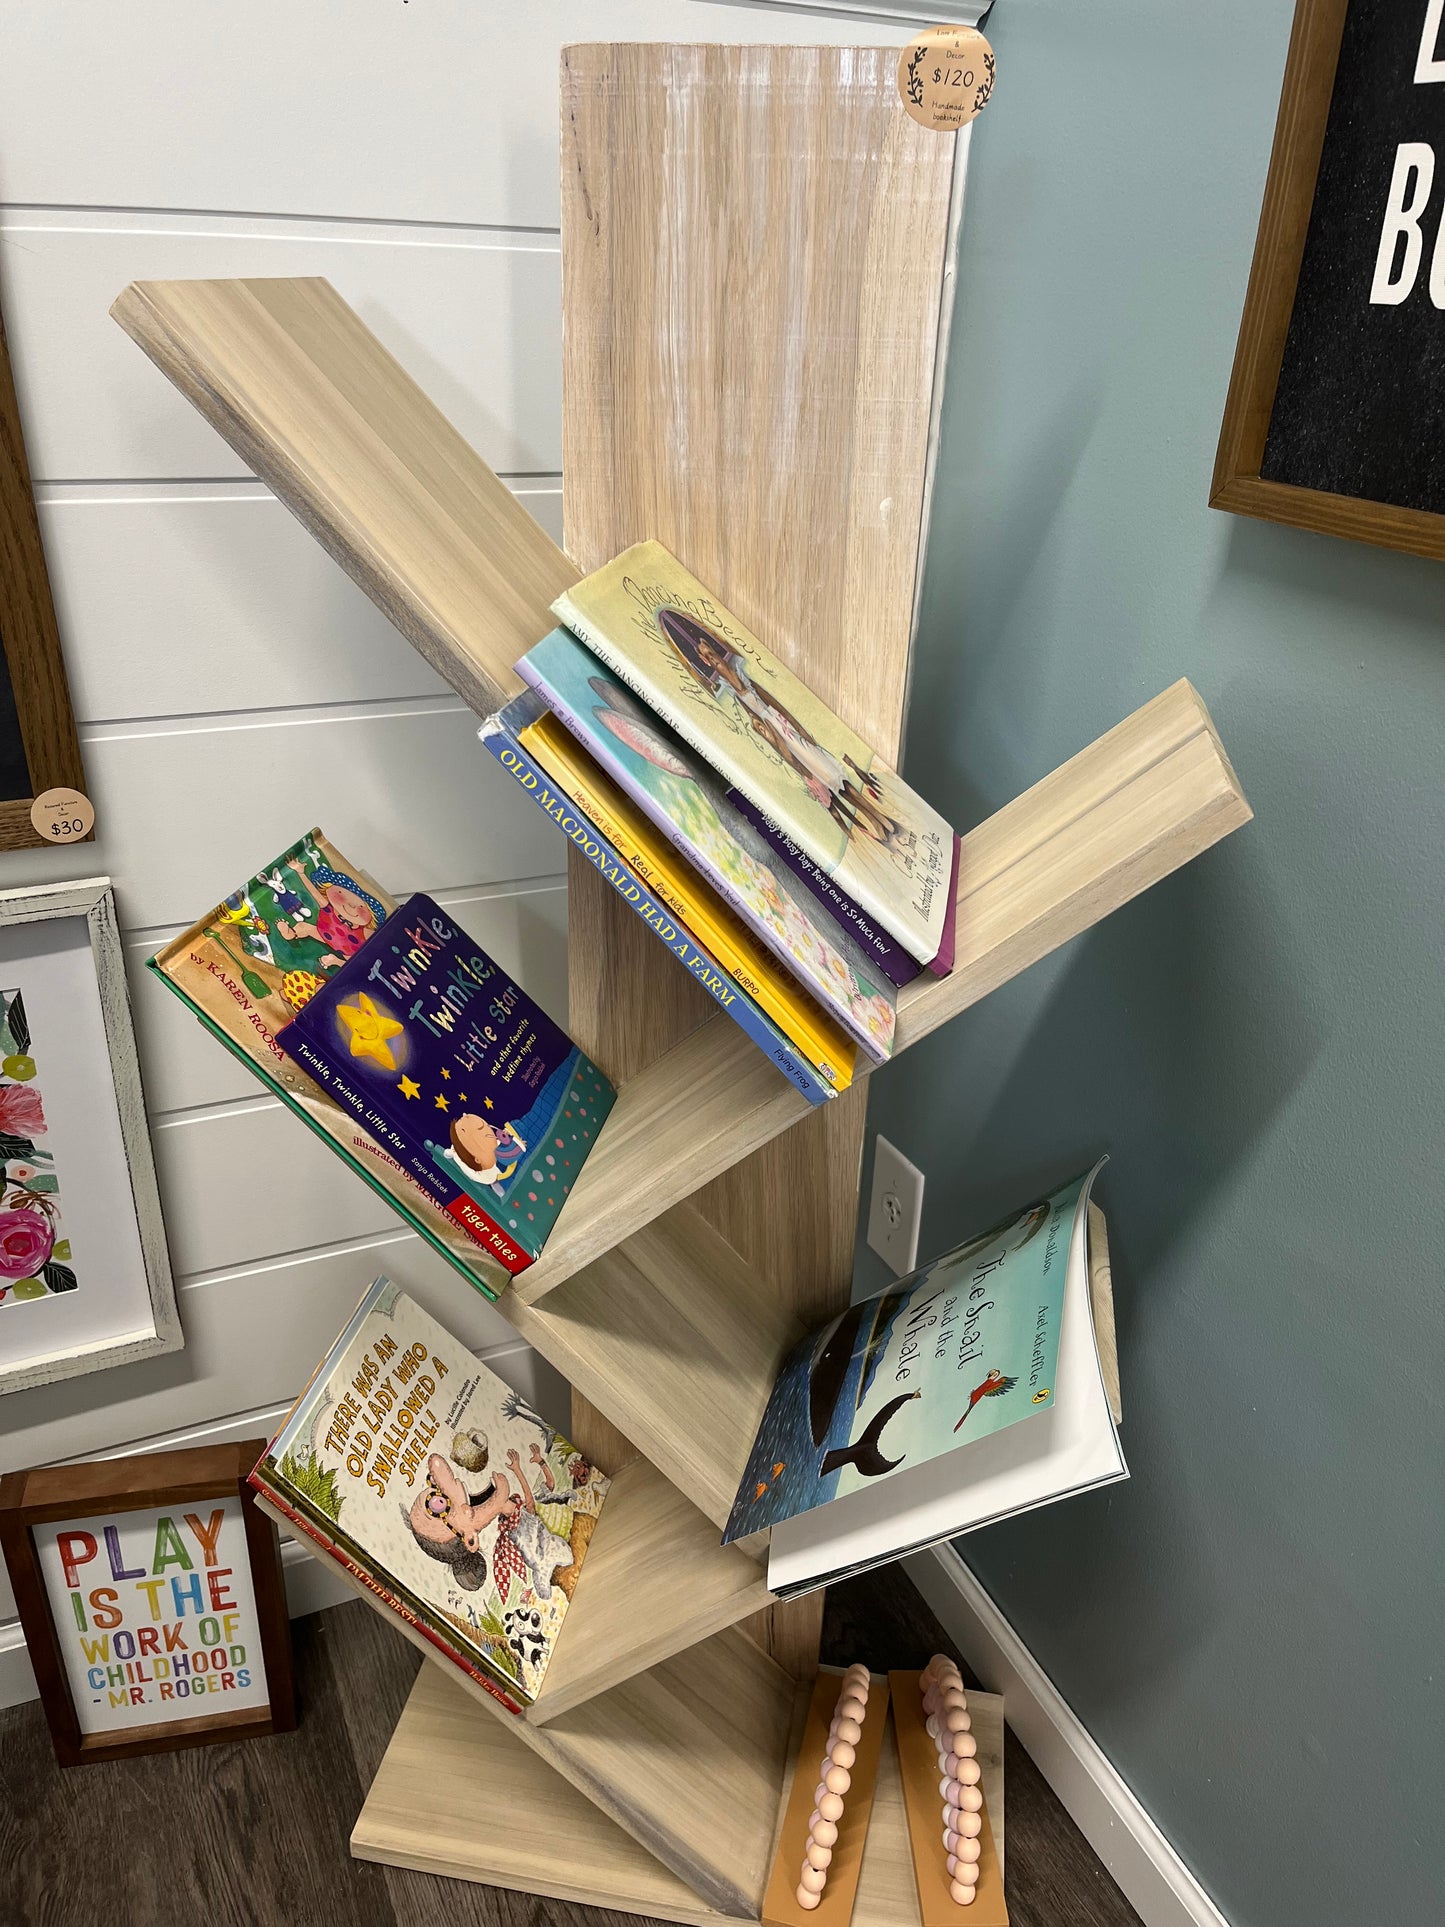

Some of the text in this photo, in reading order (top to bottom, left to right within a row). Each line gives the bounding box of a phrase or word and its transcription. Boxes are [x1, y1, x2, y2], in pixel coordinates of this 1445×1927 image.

[932, 67, 974, 87] $120
[946, 50, 965, 59] Decor
[933, 113, 962, 123] bookshelf
[1369, 142, 1445, 310] B
[622, 576, 704, 624] Dancing
[697, 597, 778, 680] Bear
[569, 623, 592, 643] AMY
[593, 642, 612, 665] THE
[613, 665, 655, 707] DANCING
[655, 706, 680, 731] BEAR
[532, 682, 557, 709] James
[564, 717, 590, 746] Brown
[672, 833, 704, 871] Grandma
[51, 819, 83, 836] $30
[501, 749, 736, 1007] OLD MACDONALD HAD A FARM
[572, 791, 760, 995] Heaven is for Real for kids BURPO
[811, 868, 831, 892] Being
[841, 902, 849, 912] is
[847, 908, 857, 920] So
[368, 916, 459, 1000] Twinkle,
[190, 953, 286, 1062] by KAREN ROOSA
[408, 954, 497, 1038] Twinkle,
[453, 985, 520, 1072] Little Star
[490, 1018, 528, 1076] and other favorite
[503, 1034, 535, 1082] bedtime rhymes
[774, 1048, 811, 1089] Flying Frog
[298, 1043, 330, 1080] Twinkle,
[332, 1077, 364, 1113] Twinkle,
[365, 1110, 387, 1134] Little
[388, 1131, 406, 1151] Star
[411, 1157, 428, 1176] Sanja
[461, 1204, 491, 1235] tiger
[488, 1232, 517, 1261] tales
[352, 1136, 402, 1171] illustrated
[402, 1168, 415, 1183] by
[1043, 1226, 1060, 1276] Donaldson
[895, 1288, 946, 1382] Whale
[935, 1296, 959, 1359] and the
[958, 1249, 1007, 1370] The Snail
[1032, 1305, 1049, 1331] Axel
[1029, 1331, 1048, 1387] Scheffler
[324, 1333, 398, 1455] THERE WAS AN
[346, 1342, 428, 1478] OLD LADY WHO
[444, 1416, 452, 1425] by
[448, 1399, 460, 1418] Lucille
[462, 1397, 469, 1408] by
[473, 1375, 481, 1386] Lee
[366, 1356, 449, 1498] SWALLOWED A
[399, 1409, 441, 1487] SHELL!
[56, 1509, 225, 1588] PLAY
[70, 1568, 237, 1633] IS THE
[345, 1561, 365, 1581] I'M
[364, 1576, 388, 1601] THE
[387, 1598, 418, 1625] BEST!
[80, 1613, 241, 1665] WORK OF
[88, 1645, 247, 1689] CHILDHOOD
[108, 1687, 153, 1709] MR.
[159, 1669, 251, 1701] ROGERS
